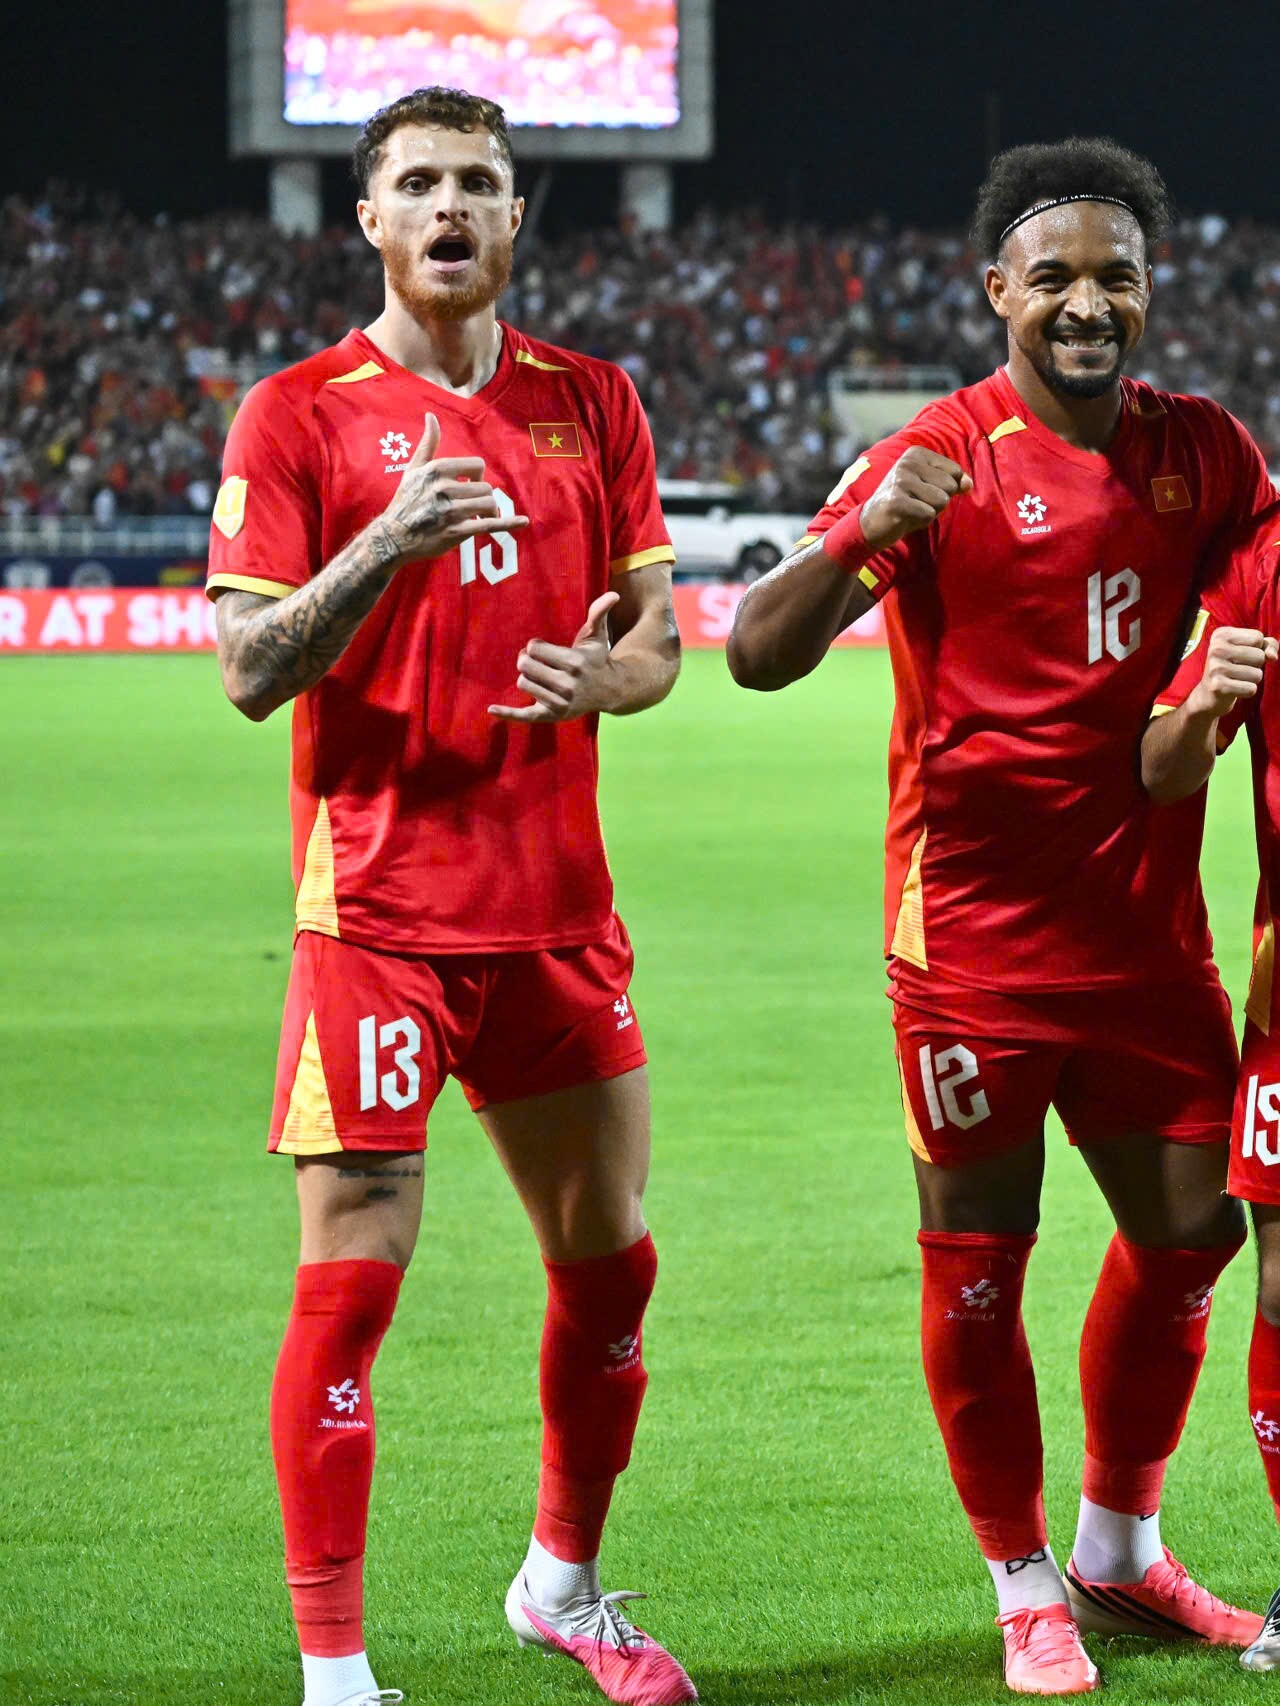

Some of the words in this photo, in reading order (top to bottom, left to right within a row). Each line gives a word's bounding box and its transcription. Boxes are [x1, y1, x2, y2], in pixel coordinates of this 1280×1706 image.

[39, 595, 115, 646] AT
[1087, 566, 1142, 666] 12
[358, 1014, 422, 1113] 13
[918, 1043, 992, 1131] 12
